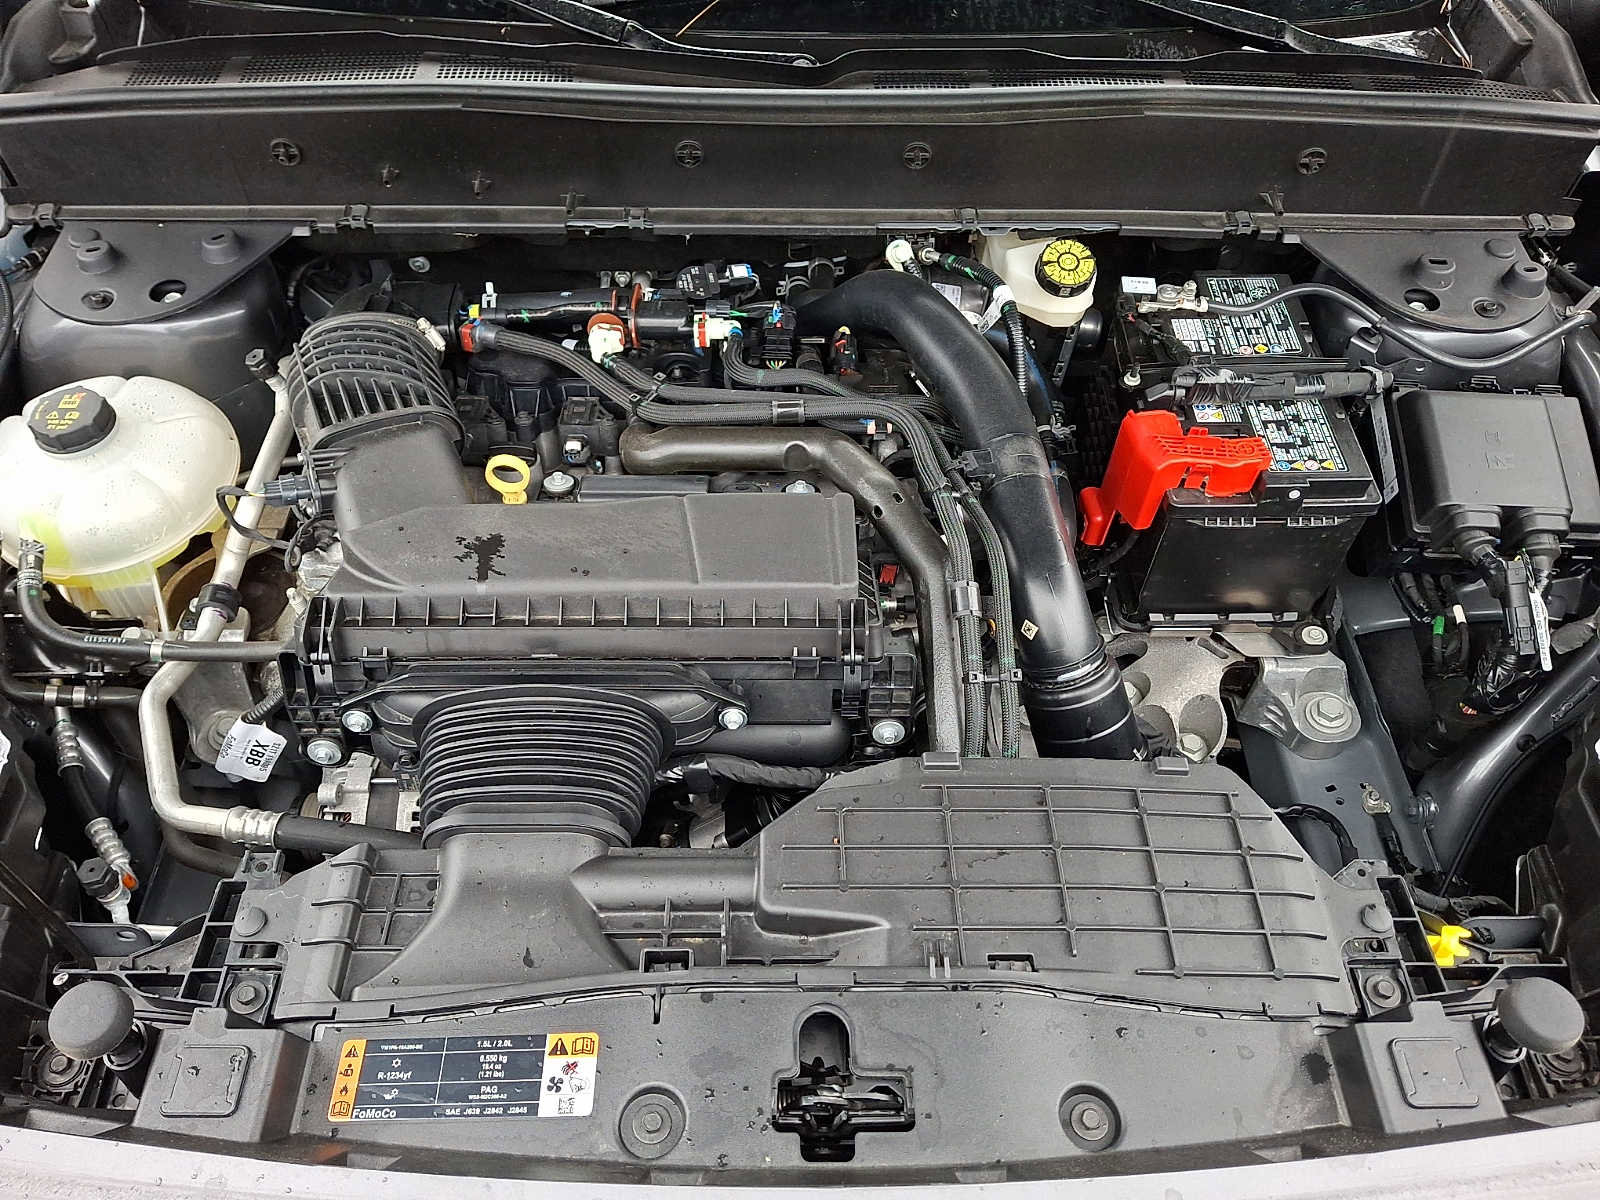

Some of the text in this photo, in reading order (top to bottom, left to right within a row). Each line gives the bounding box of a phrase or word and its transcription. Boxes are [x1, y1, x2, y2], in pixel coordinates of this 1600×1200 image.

[245, 739, 270, 766] XBB
[477, 1040, 492, 1048] 1.5L
[497, 1039, 513, 1047] 2.0L
[498, 1054, 508, 1064] kg
[377, 1071, 413, 1081] R-1234yf
[480, 1085, 498, 1094] PAG
[352, 1108, 397, 1119] FoMoCo
[444, 1107, 461, 1116] SAE
